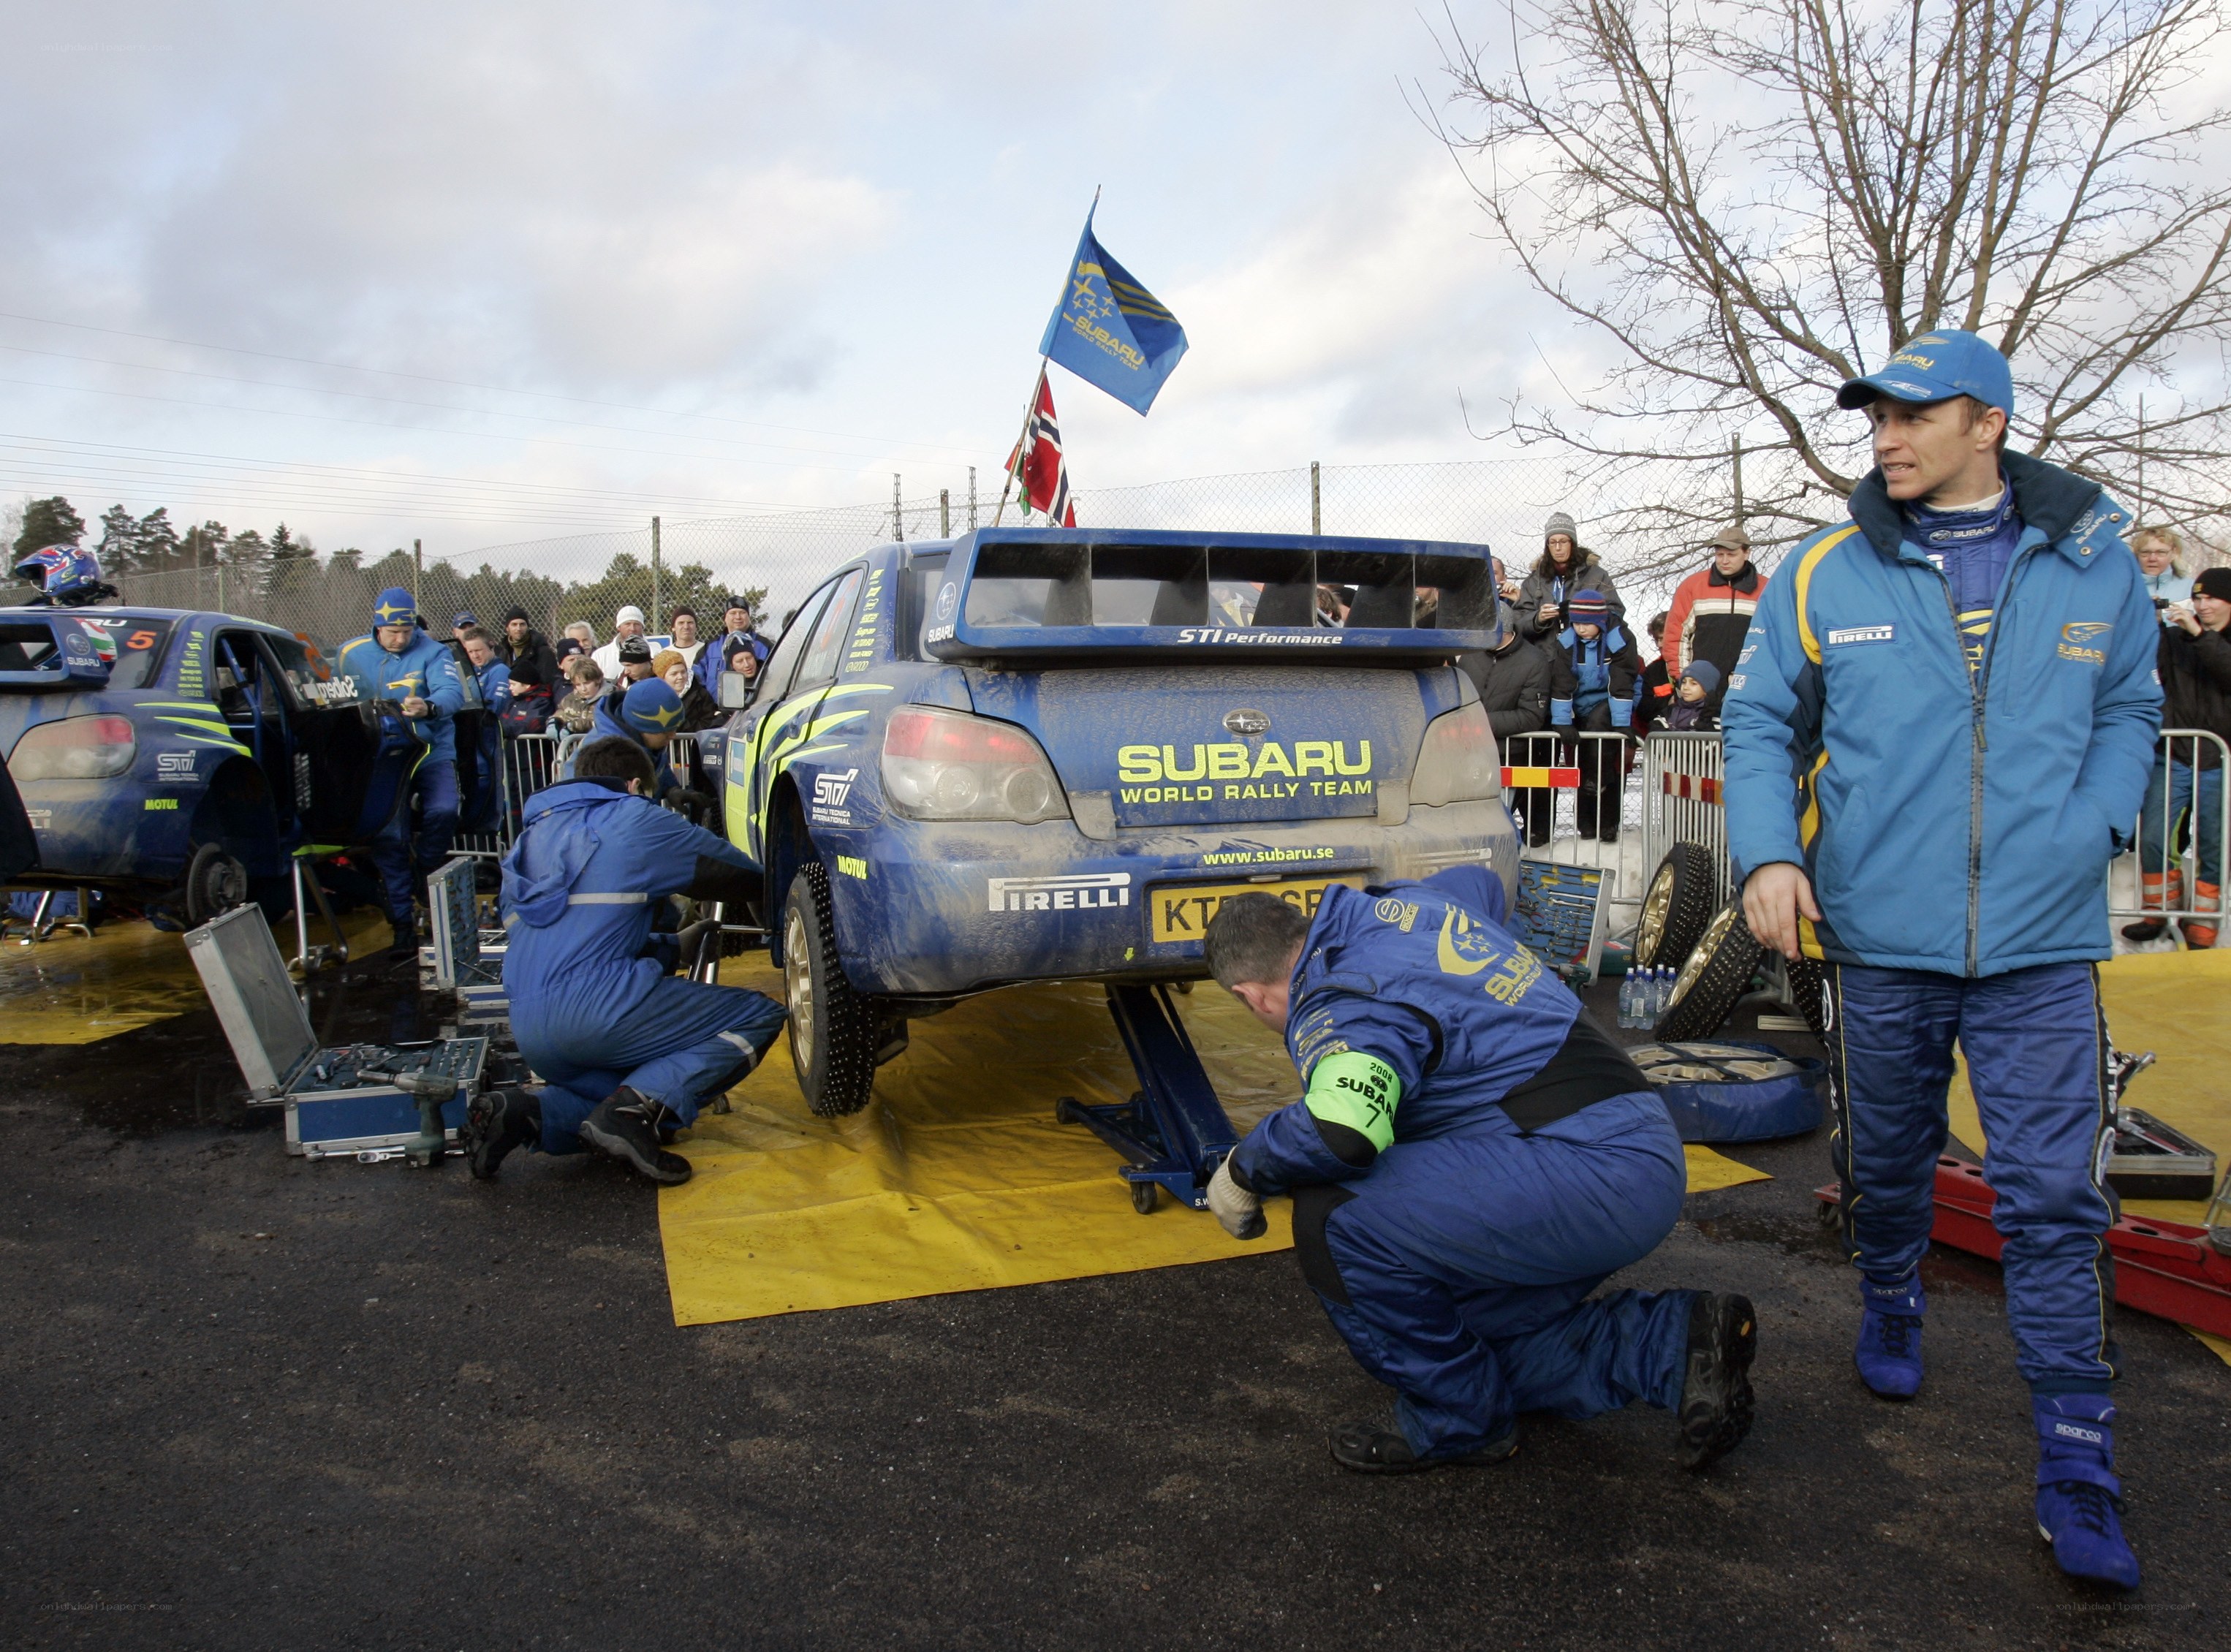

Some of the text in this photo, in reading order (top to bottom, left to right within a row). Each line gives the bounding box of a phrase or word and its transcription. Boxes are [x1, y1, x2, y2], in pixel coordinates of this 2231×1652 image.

[1072, 326, 1095, 342] WORLD
[1075, 315, 1145, 365] SUBARU
[1952, 524, 1996, 538] SUBARU
[125, 630, 157, 651] 5
[927, 624, 955, 643] SUBARU
[1177, 629, 1343, 644] STI Performance
[1828, 625, 1893, 644] PIRELLI
[67, 656, 100, 667] SUBARU
[1118, 740, 1371, 783] SUBARU
[1121, 780, 1372, 803] WORLD RALLY TEAM
[145, 799, 178, 810] MOTUL
[812, 806, 850, 817] SUBARU TECNICA
[812, 814, 850, 825] INTERNATIONAL
[1203, 847, 1334, 865] www.subaru.se
[837, 855, 867, 880] MOTUL
[988, 873, 1130, 912] PIRELLI
[1366, 1102, 1381, 1128] 7
[2055, 1422, 2102, 1444] sparco
